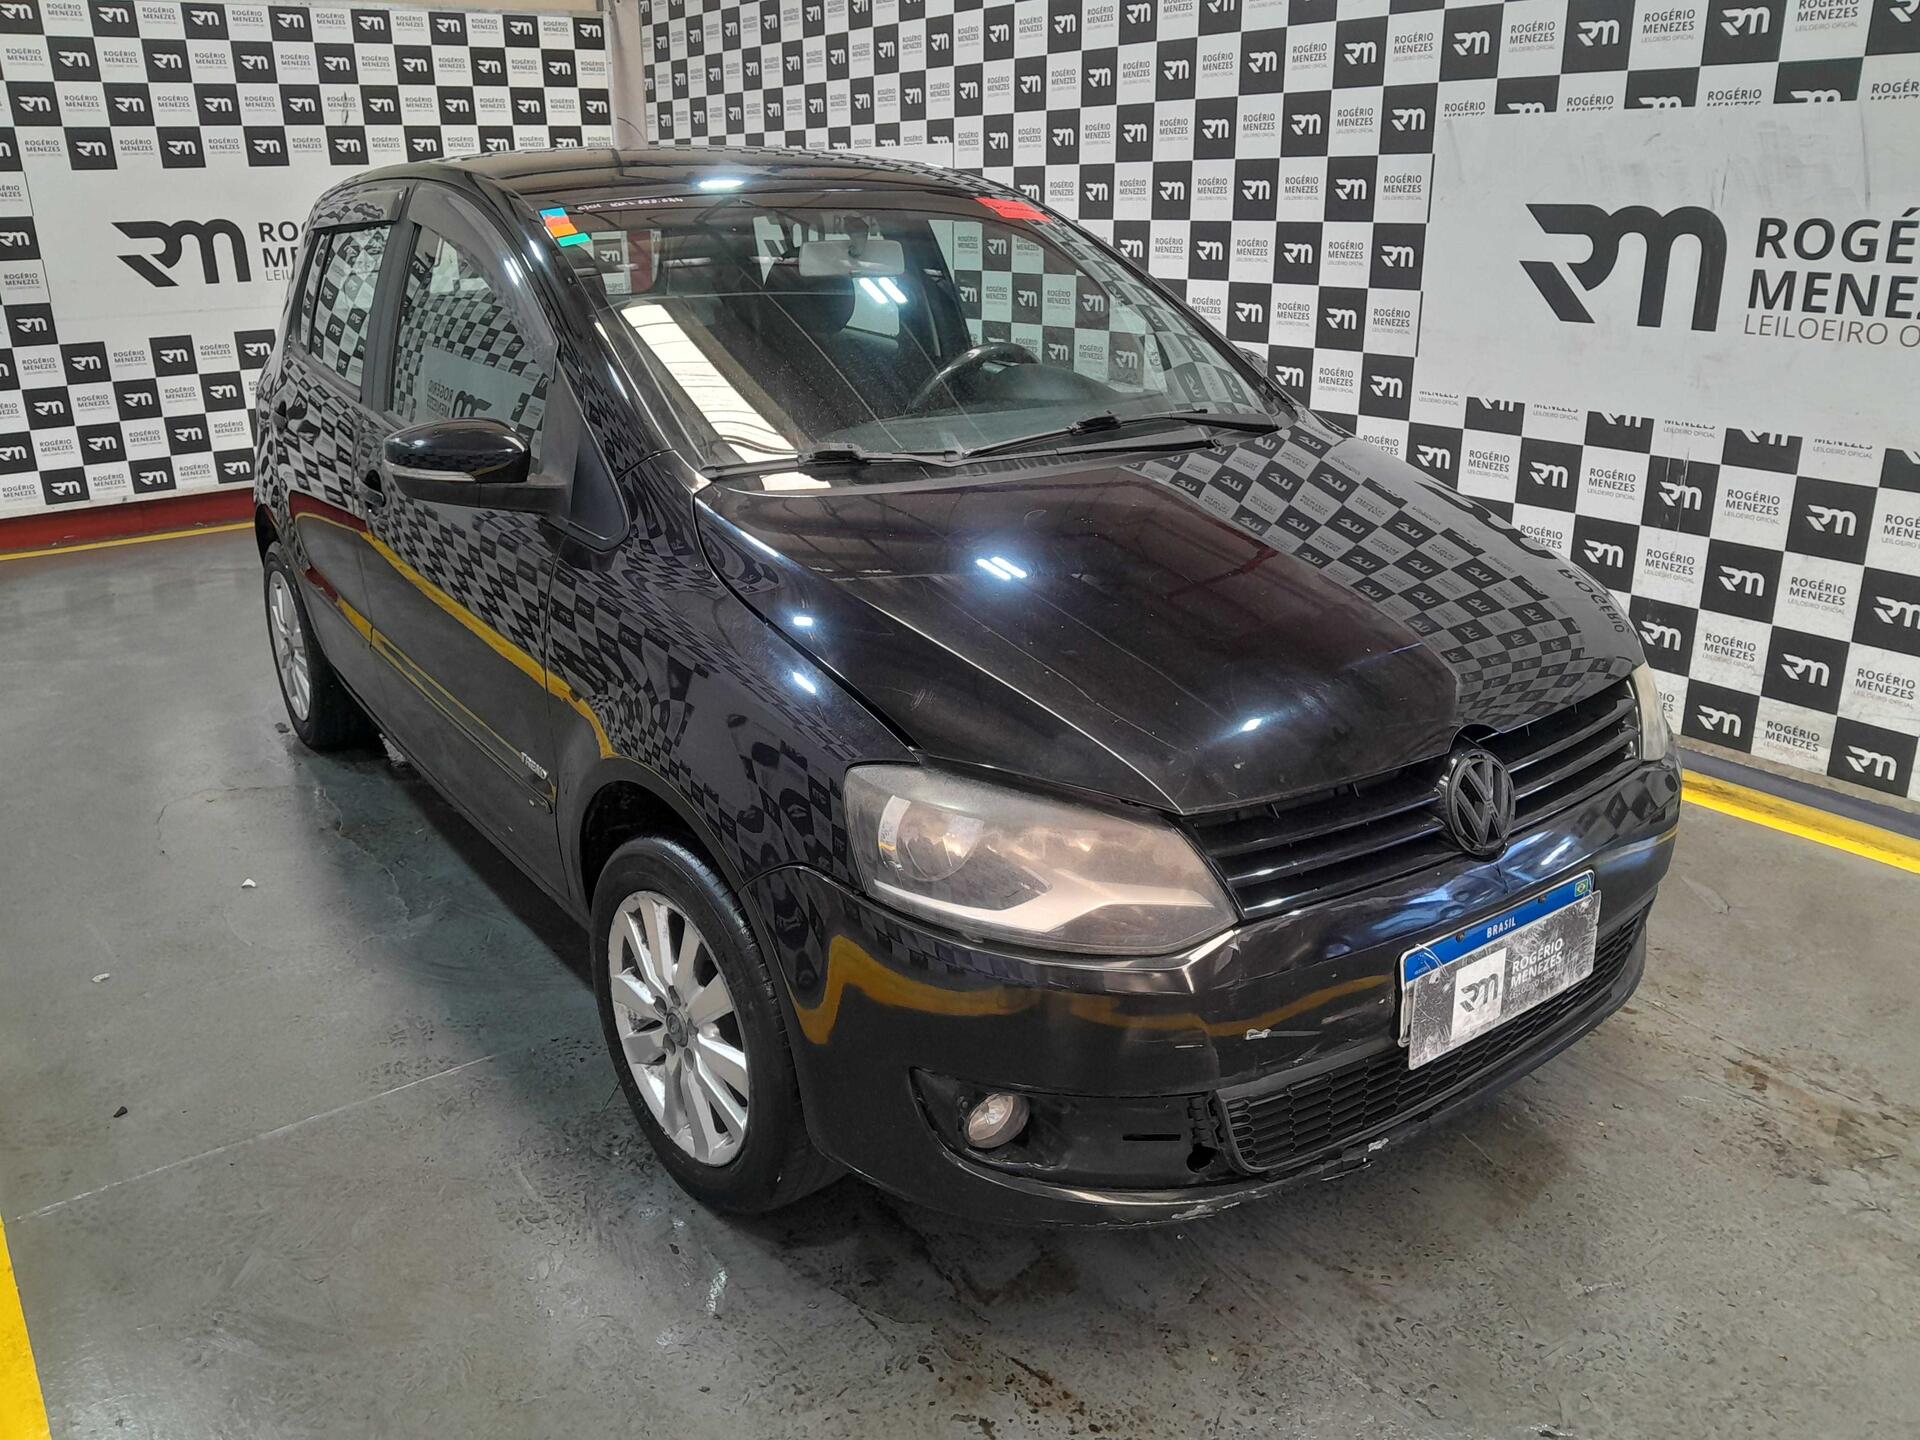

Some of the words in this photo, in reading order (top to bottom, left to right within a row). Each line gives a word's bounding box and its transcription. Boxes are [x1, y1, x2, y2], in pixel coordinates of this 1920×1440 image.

[46, 2, 80, 10] ROGÉRIO
[1087, 5, 1113, 16] ROGÉRIO
[1087, 13, 1113, 24] MENEZES
[1643, 7, 1697, 22] ROGÉRIO
[1796, 5, 1859, 22] MENEZES
[1510, 20, 1556, 34] ROGÉRIO
[1642, 19, 1696, 34] MENEZES
[1394, 31, 1434, 44] ROGÉRIO
[1509, 31, 1555, 44] MENEZES
[5, 47, 40, 55] ROGÉRIO
[1292, 42, 1327, 54] ROGÉRIO
[1393, 42, 1433, 54] MENEZES
[1202, 52, 1233, 63] ROGÉRIO
[1292, 52, 1327, 63] MENEZES
[1122, 60, 1150, 70] ROGÉRIO
[1202, 61, 1233, 72] MENEZES
[1051, 68, 1076, 77] ROGÉRIO
[1122, 69, 1150, 78] MENEZES
[1051, 76, 1076, 85] MENEZES
[1871, 79, 1920, 94] ROGÉR
[1706, 87, 1762, 101] ROGÉRIO
[1444, 100, 1486, 112] ROGÉRIO
[1565, 94, 1614, 107] ROGÉRIO
[1243, 112, 1275, 122] ROGÉRIO
[1337, 106, 1373, 117] ROGÉRIO
[1160, 117, 1188, 127] ROGÉRIO
[1242, 122, 1275, 131] MENEZES
[1336, 116, 1373, 127] MENEZES
[1159, 126, 1188, 135] MENEZES
[1198, 176, 1227, 186] ROGÉRIO
[1284, 175, 1318, 184] ROGÉRIO
[1384, 173, 1422, 183] ROGÉRIO
[1197, 186, 1227, 194] MENEZES
[1284, 185, 1318, 193] MENEZES
[1383, 184, 1422, 193] MENEZES
[1755, 207, 1920, 264] ROGÉ
[1155, 237, 1183, 246] ROGÉRIO
[1236, 238, 1268, 248] ROGÉRIO
[1328, 240, 1363, 250] ROGÉRIO
[1155, 246, 1183, 254] MENEZES
[1236, 248, 1267, 256] MENEZES
[1327, 250, 1363, 259] MENEZES
[1747, 269, 1920, 321] MENE
[1277, 302, 1309, 311] ROGÉRIO
[1276, 310, 1309, 320] MENEZES
[1373, 308, 1410, 318] ROGÉRIO
[1372, 317, 1410, 328] MENEZES
[1744, 313, 1888, 345] LEILOEIRO
[21, 357, 55, 365] ROGÉRIO
[113, 355, 145, 363] MENEZES
[22, 363, 56, 371] MENEZES
[1319, 367, 1353, 378] ROGÉRIO
[1318, 376, 1353, 387] MENEZES
[76, 393, 107, 402] ROGÉRIO
[77, 398, 109, 407] MENEZES
[129, 434, 161, 442] MENEZES
[1363, 435, 1399, 447] ROGÉRIO
[1469, 450, 1510, 463] ROGÉRIO
[1468, 458, 1509, 472] MENEZES
[92, 473, 123, 482] ROGÉRIO
[1589, 468, 1636, 483] ROGÉRIO
[93, 479, 125, 487] MENEZES
[1588, 477, 1635, 493] MENEZES
[1726, 488, 1780, 505] ROGÉRIO
[1725, 498, 1779, 516] MENEZES
[1520, 524, 1563, 539] ROGÉRIO
[1646, 548, 1695, 565] ROGÉRIO
[1644, 558, 1694, 575] MENEZES
[1790, 575, 1847, 595] ROGÉRIO
[1788, 585, 1846, 606] MENEZES
[1704, 632, 1756, 652] ROGÉRIO
[1703, 641, 1755, 662] MENEZES
[1855, 667, 1917, 689] ROGÉRIO
[1853, 677, 1915, 700] MENEZES
[1765, 720, 1820, 742] ROGÉRIO
[1763, 729, 1819, 752] MENEZES
[1486, 917, 1516, 939] BRASIL
[1511, 938, 1563, 975] ROGÉRIO
[1511, 951, 1562, 988] MENEZES
